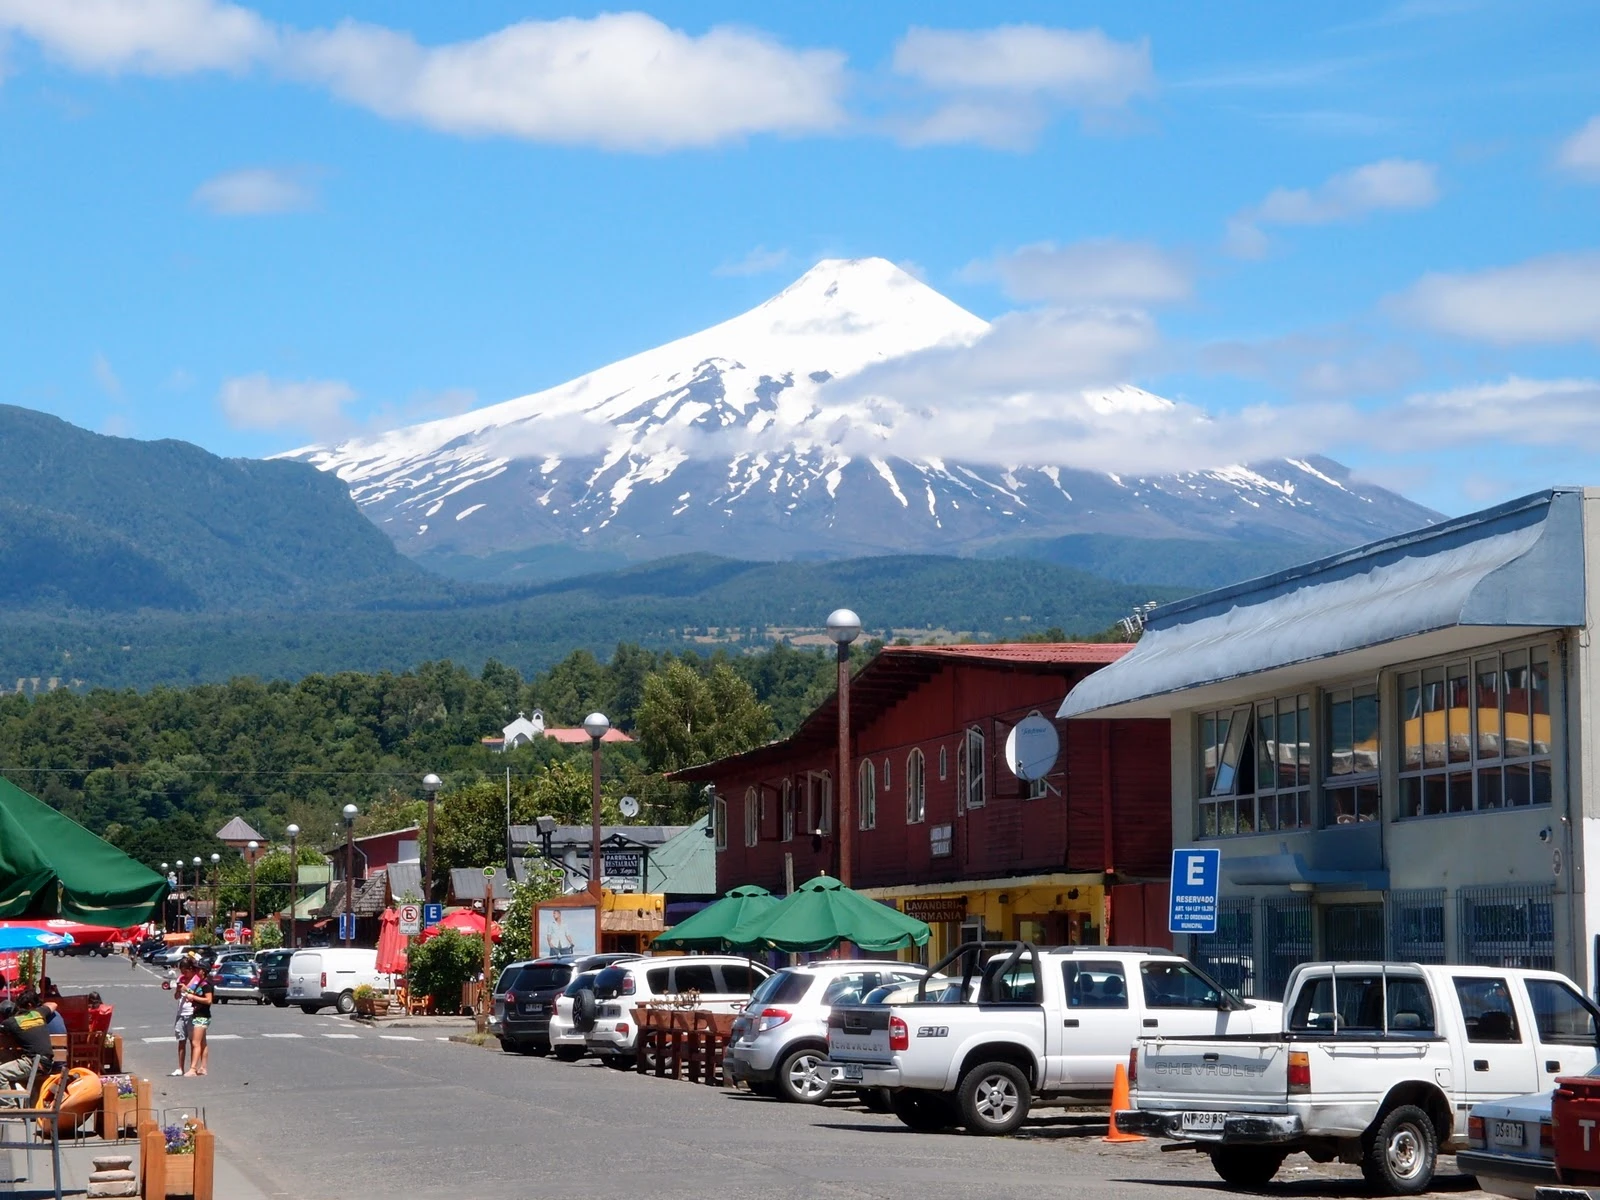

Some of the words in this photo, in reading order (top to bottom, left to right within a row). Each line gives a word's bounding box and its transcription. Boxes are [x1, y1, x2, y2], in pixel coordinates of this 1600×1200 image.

[1187, 856, 1205, 885] E
[906, 900, 962, 910] LAVANDERIA
[430, 907, 437, 918] E
[908, 911, 962, 920] GERMANIA
[919, 1027, 948, 1036] S-10
[1155, 1062, 1267, 1077] CHEVROLET
